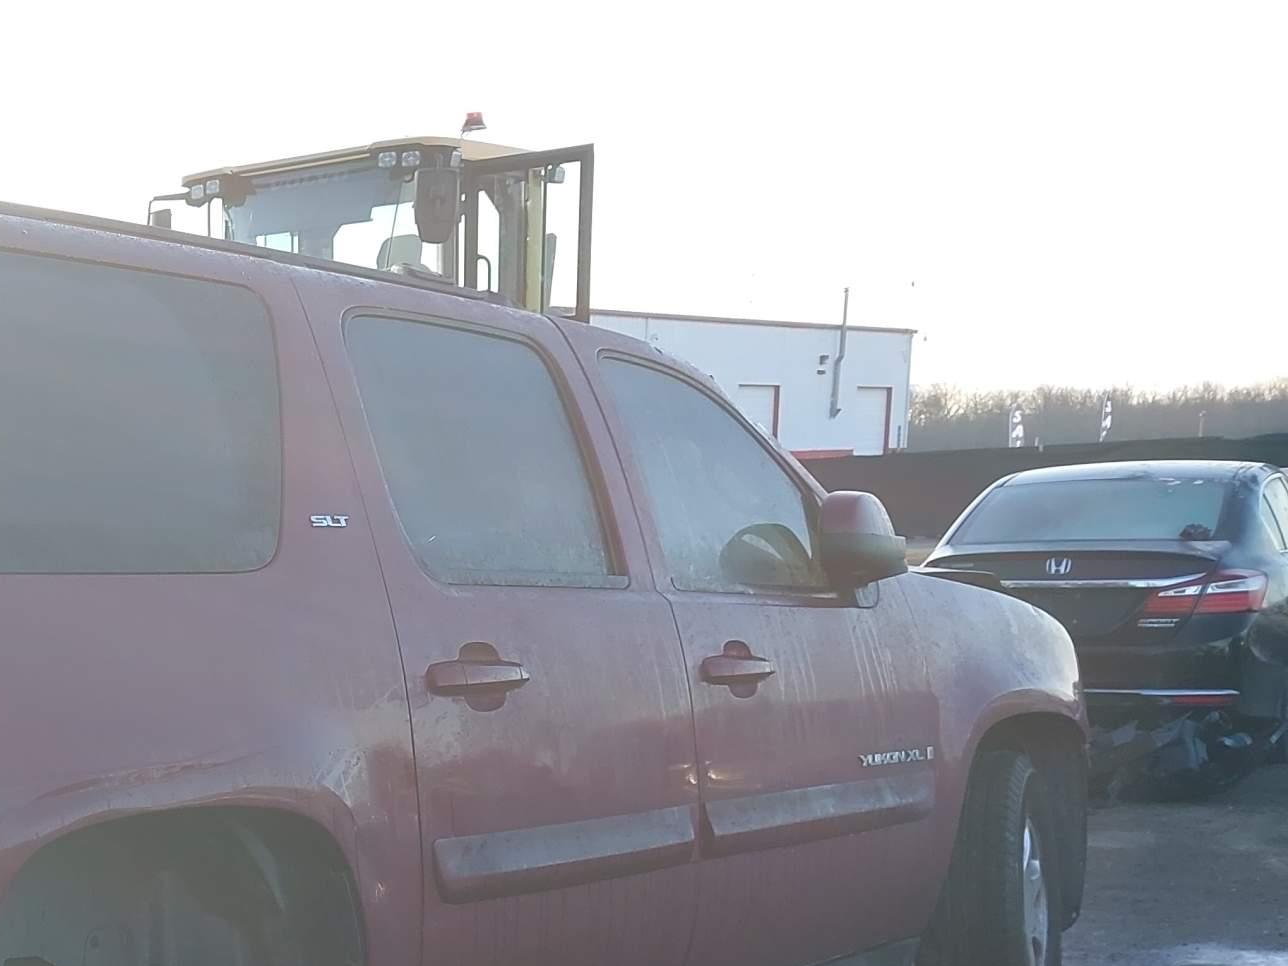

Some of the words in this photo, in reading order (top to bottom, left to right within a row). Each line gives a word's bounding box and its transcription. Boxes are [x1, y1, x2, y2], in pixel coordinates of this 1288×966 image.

[310, 515, 349, 527] SLT
[858, 751, 905, 767] YUKON
[907, 749, 925, 762] XL
